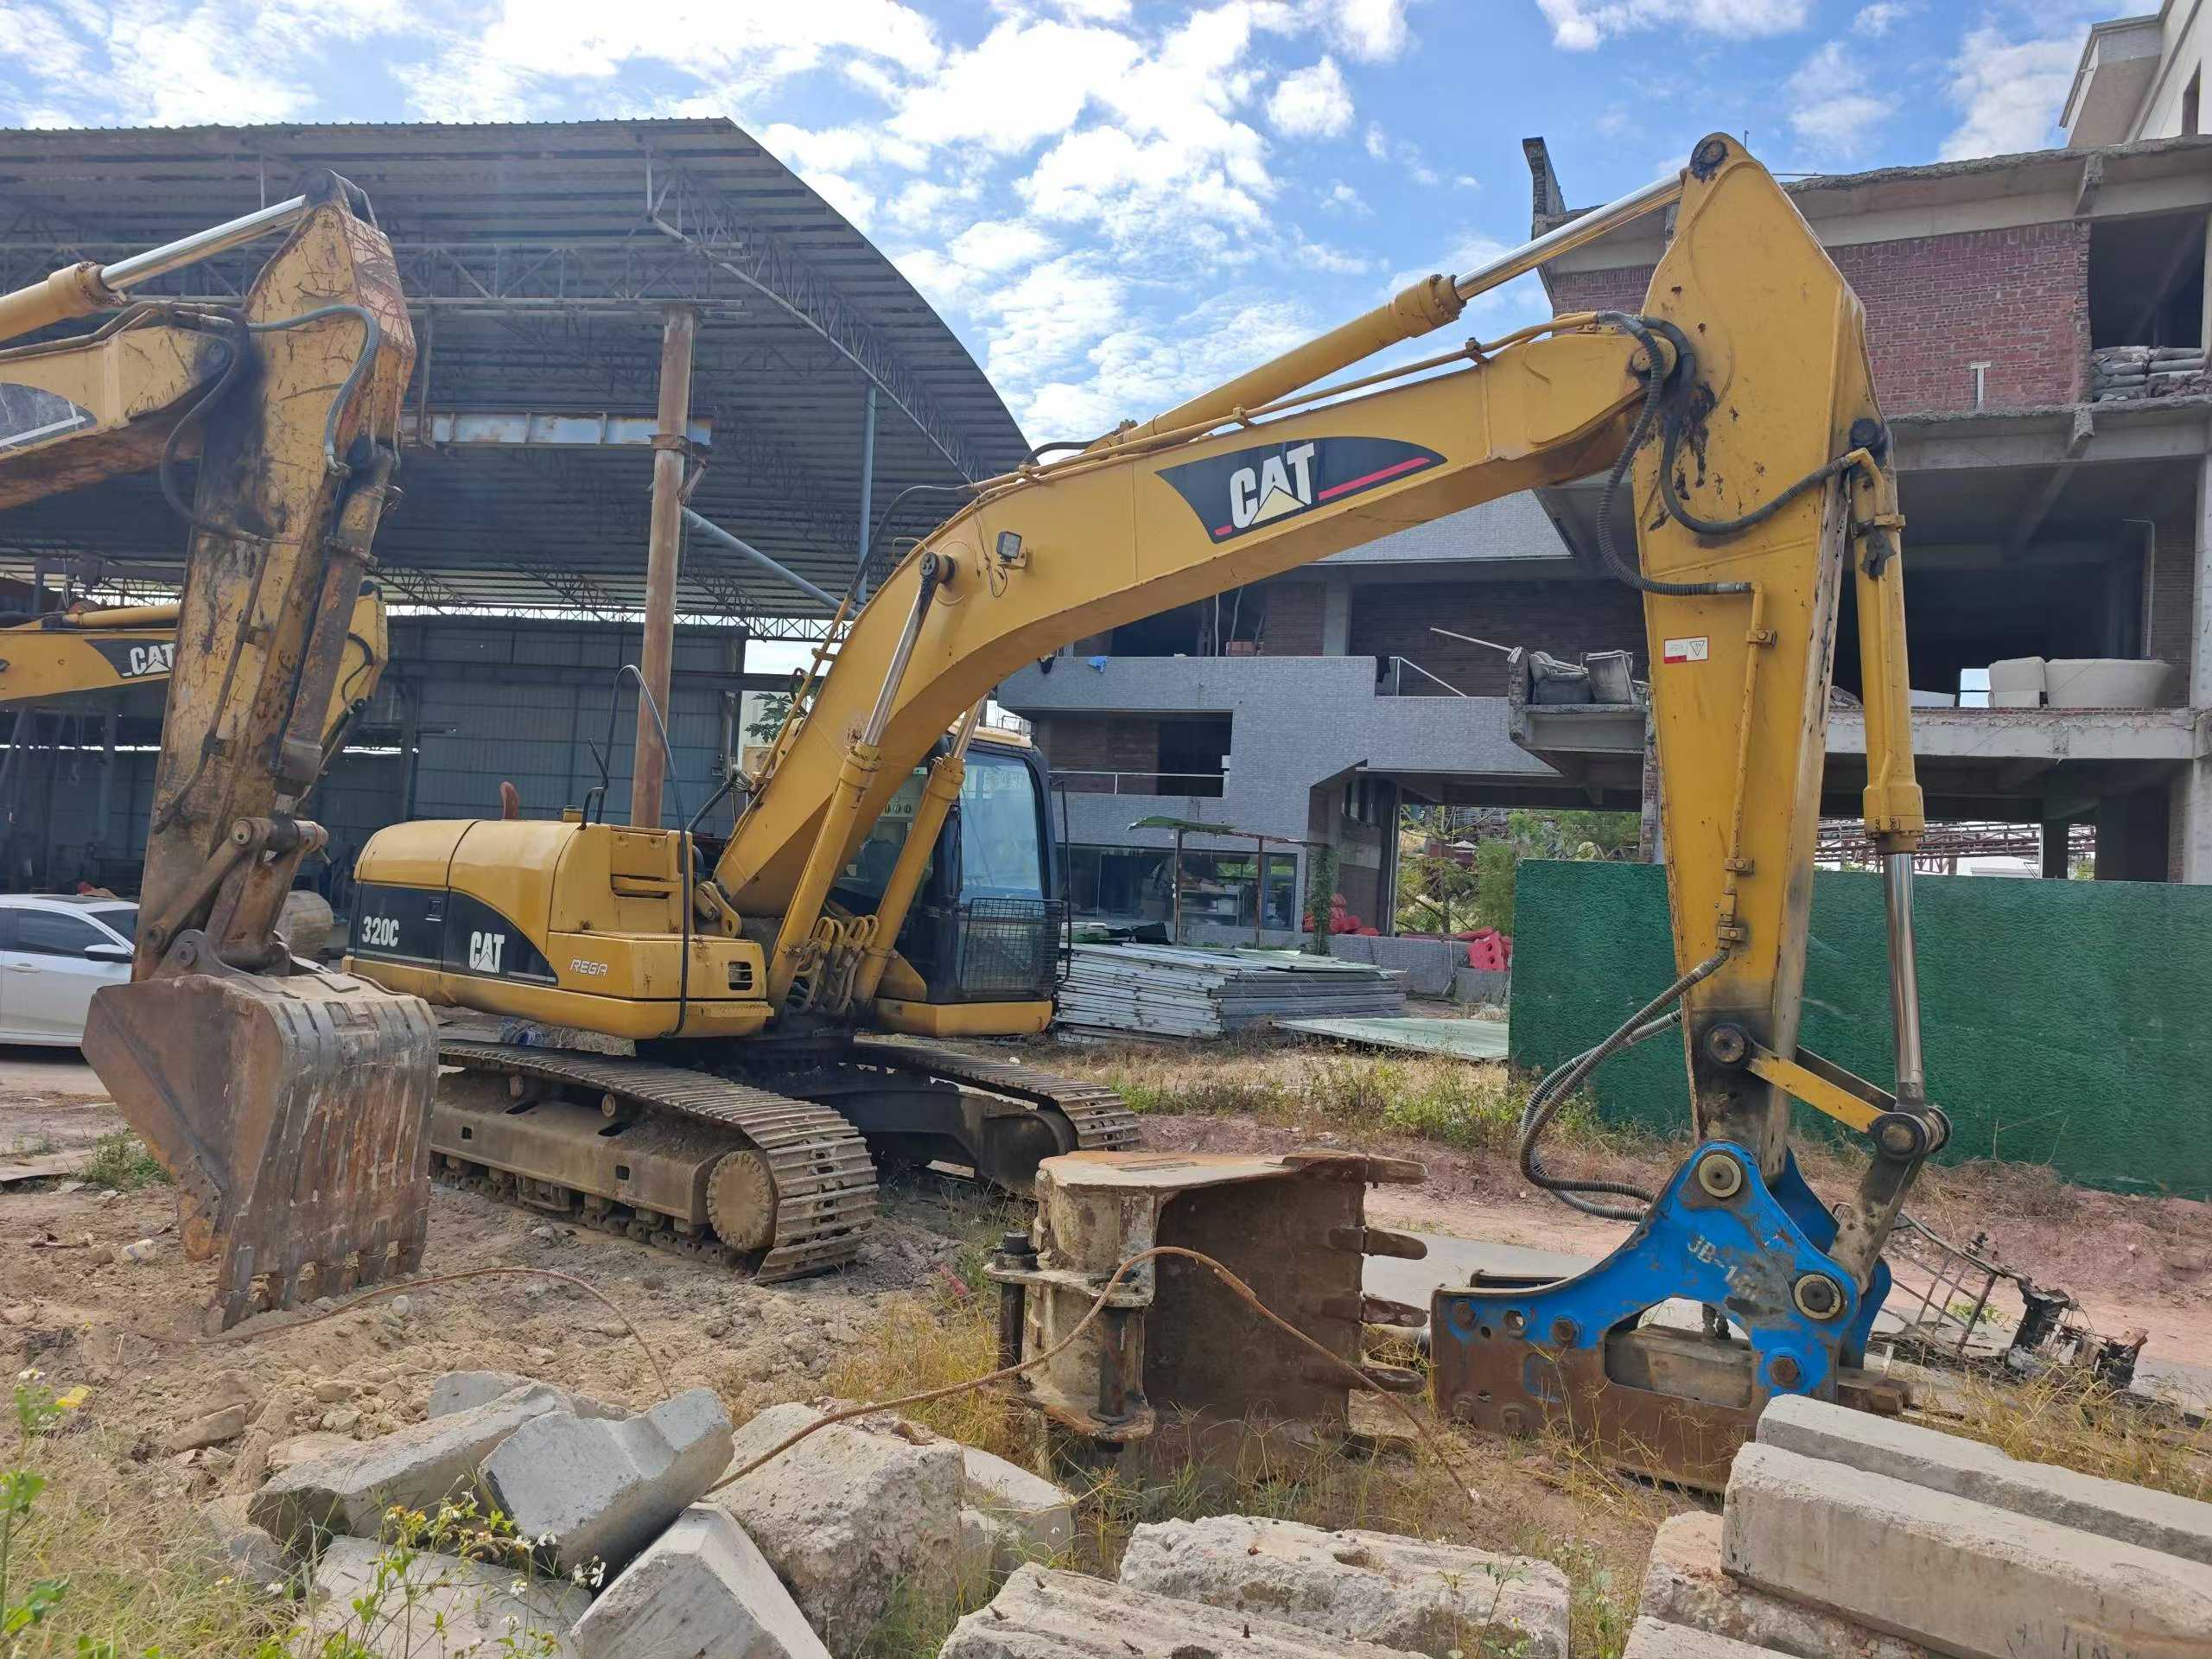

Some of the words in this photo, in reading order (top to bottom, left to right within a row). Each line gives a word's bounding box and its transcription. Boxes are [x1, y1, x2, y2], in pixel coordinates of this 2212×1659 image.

[1230, 442, 1315, 529] CAT
[130, 644, 175, 675] CAT
[361, 916, 399, 947] 320C
[469, 931, 505, 974] CAT
